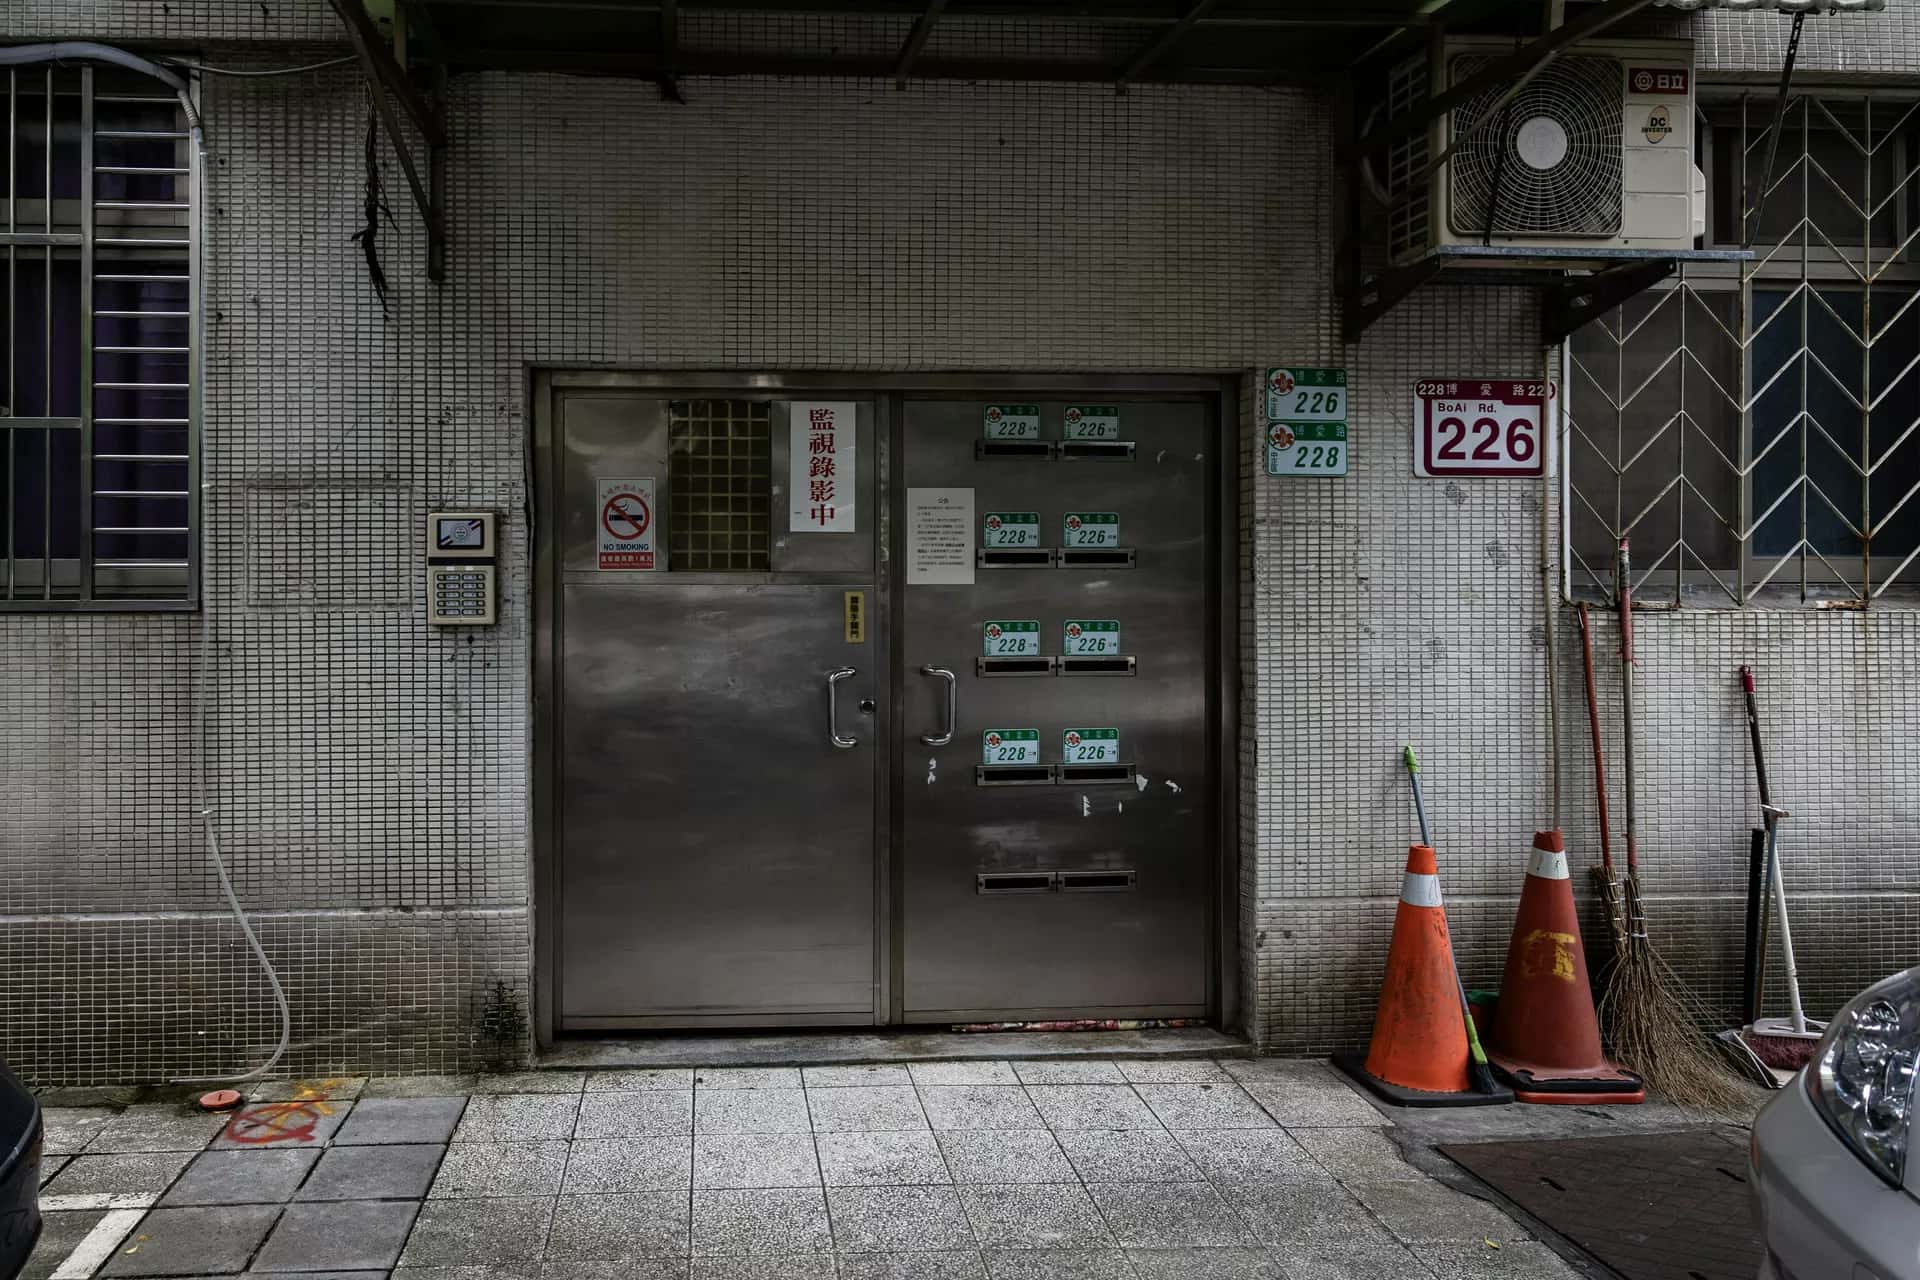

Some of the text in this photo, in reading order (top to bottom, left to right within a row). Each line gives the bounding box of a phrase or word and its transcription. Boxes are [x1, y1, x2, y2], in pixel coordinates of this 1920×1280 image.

[1656, 74, 1685, 89] 日立
[1650, 117, 1666, 126] DC
[1418, 384, 1445, 396] 228
[1446, 383, 1525, 396] 博愛路
[1295, 392, 1339, 414] 226
[1438, 402, 1497, 413] BoAi Rd.
[998, 422, 1027, 436] 228
[1078, 422, 1106, 436] 226
[1437, 417, 1535, 462] 226
[1295, 446, 1339, 468] 228
[808, 408, 836, 526] 監視錄影中
[998, 530, 1026, 544] 228
[1078, 530, 1106, 544] 226
[603, 543, 649, 551] NO SMOKING
[998, 638, 1026, 652] 228
[1078, 638, 1106, 652] 226
[998, 746, 1026, 761] 228
[1077, 745, 1106, 760] 226
